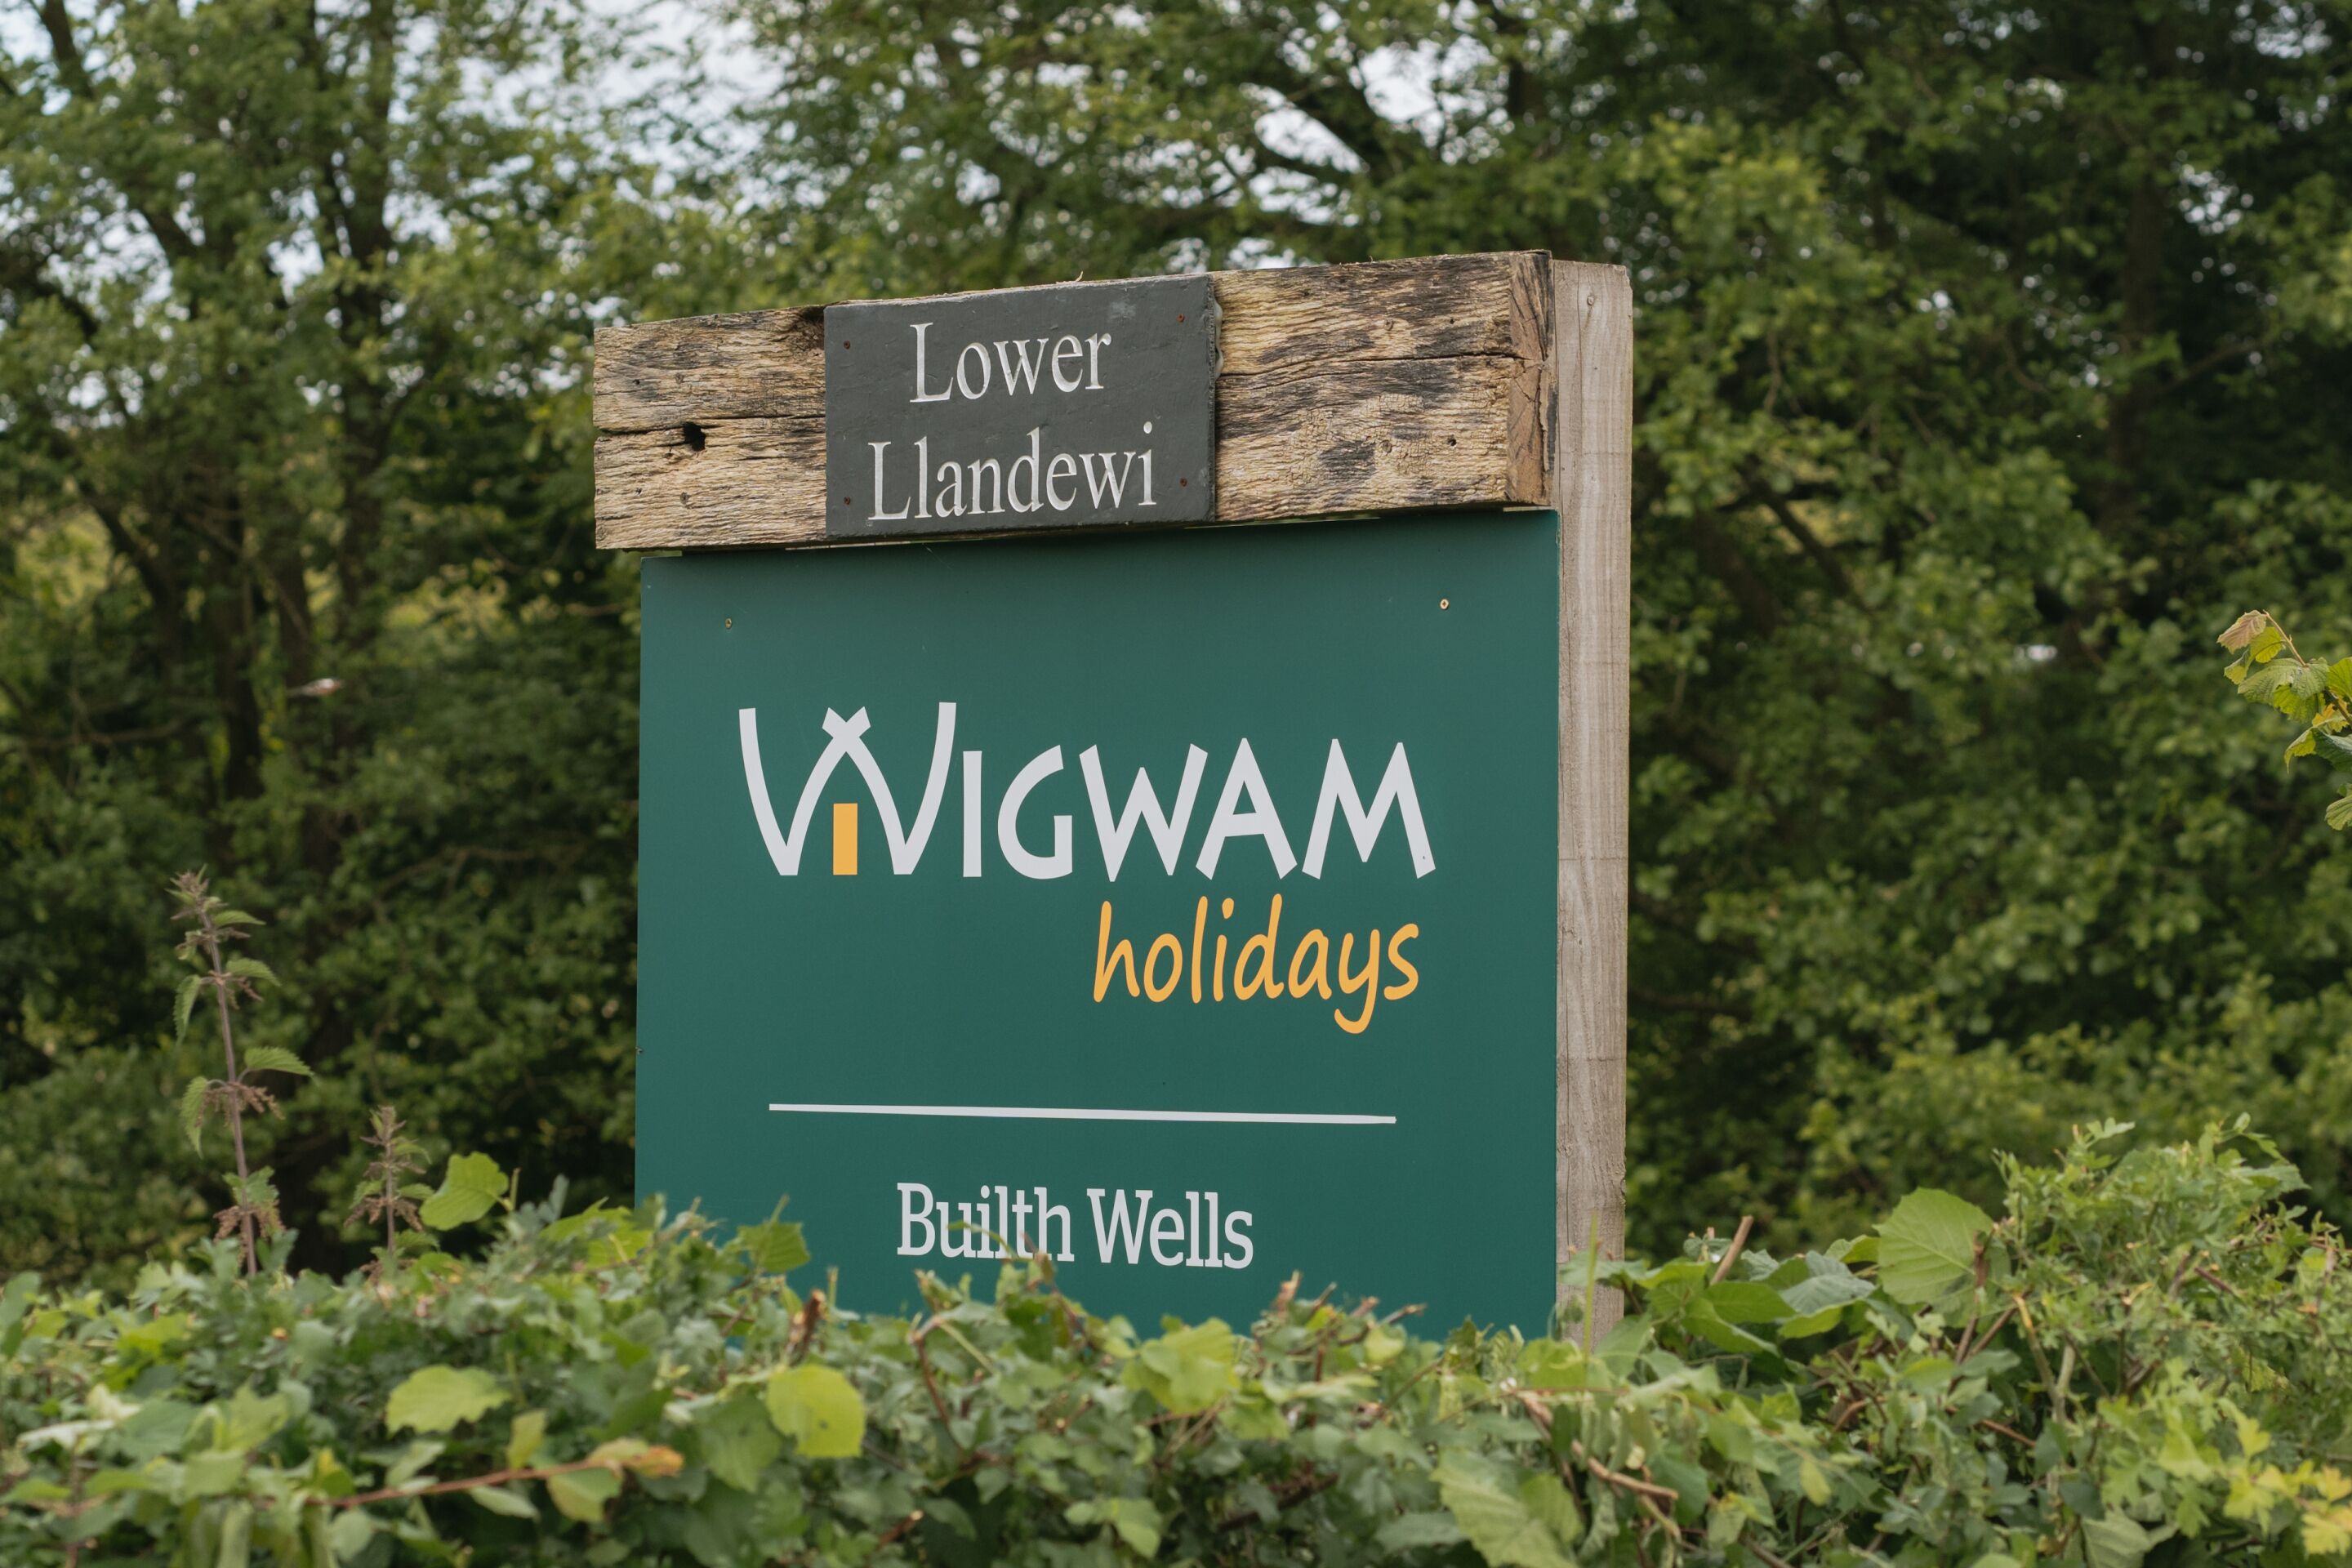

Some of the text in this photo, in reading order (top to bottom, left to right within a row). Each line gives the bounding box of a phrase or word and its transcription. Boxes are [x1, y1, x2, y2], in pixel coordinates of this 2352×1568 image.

[908, 321, 1113, 404] Lower
[866, 420, 1158, 523] Llandewi
[737, 701, 1437, 883] WIGWAM
[1092, 893, 1420, 1036] holidays
[896, 1181, 1254, 1270] Builth Wells
